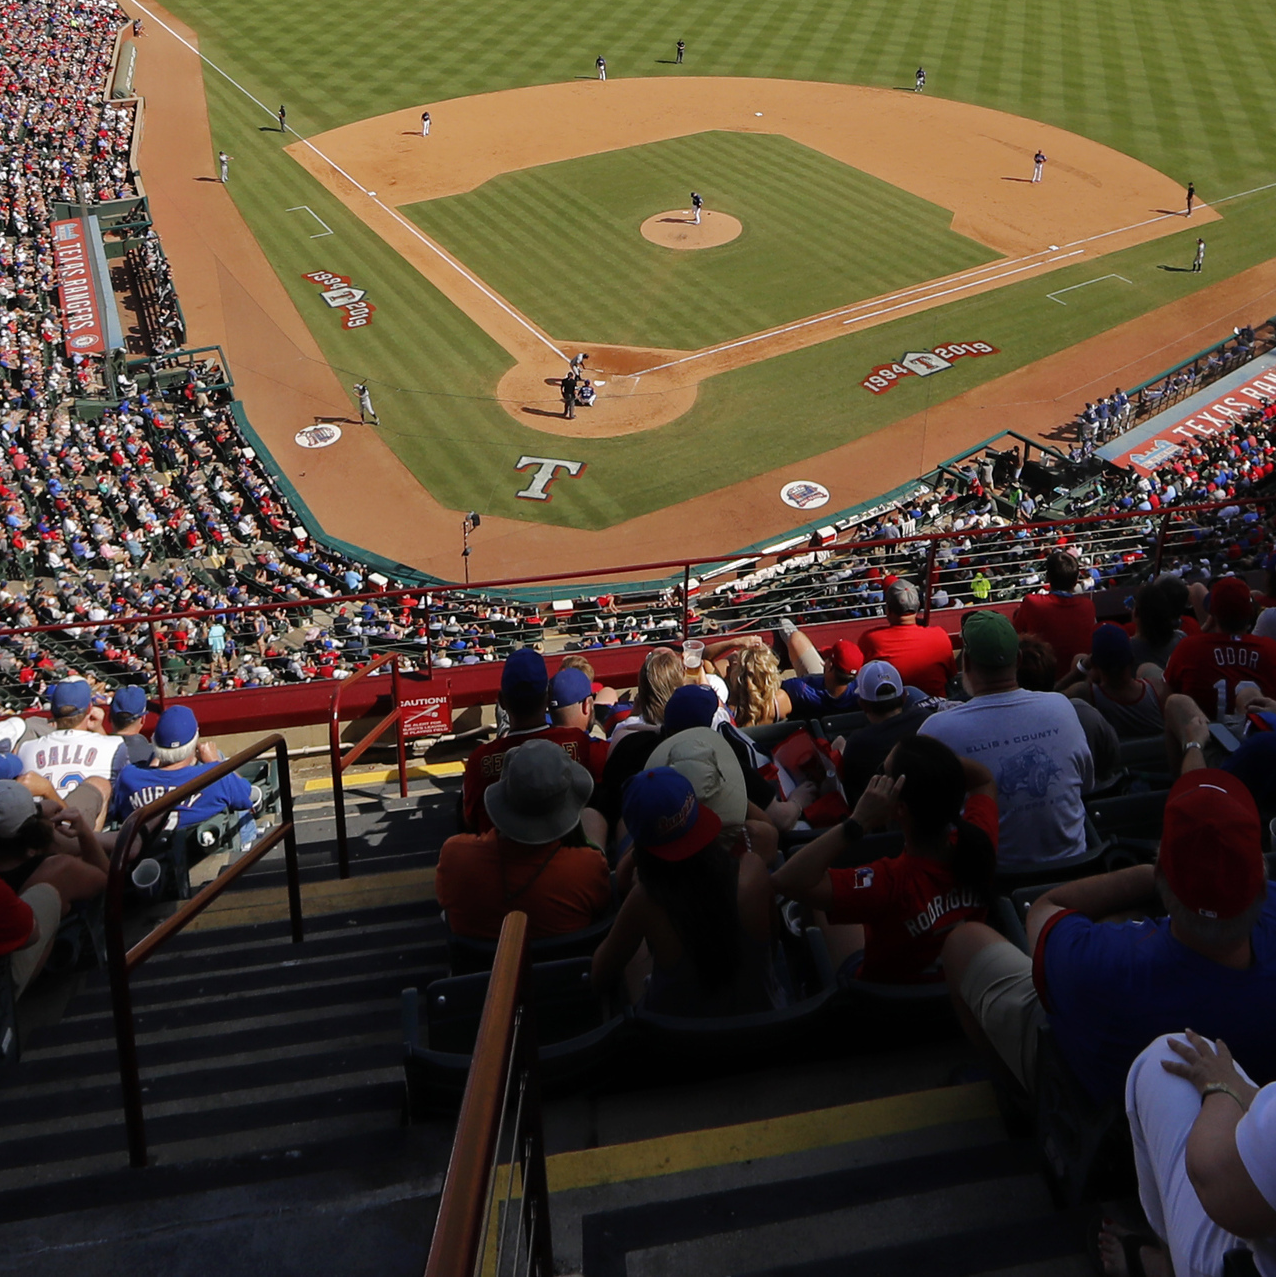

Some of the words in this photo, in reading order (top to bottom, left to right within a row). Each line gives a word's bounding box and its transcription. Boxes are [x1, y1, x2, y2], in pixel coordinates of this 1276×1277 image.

[57, 242, 86, 278] TEXAS
[64, 278, 96, 331] RANGERS
[306, 270, 346, 291] 1994
[346, 301, 371, 329] 2019
[863, 362, 909, 394] 1994
[934, 340, 994, 361] 2019
[1173, 398, 1251, 440] TEXAS
[514, 455, 587, 503] T
[1214, 648, 1259, 667] ODOR
[35, 746, 98, 770] GALLO
[965, 737, 1002, 754] ELLIS
[1012, 727, 1062, 745] COUNTY
[128, 785, 202, 810] MURY
